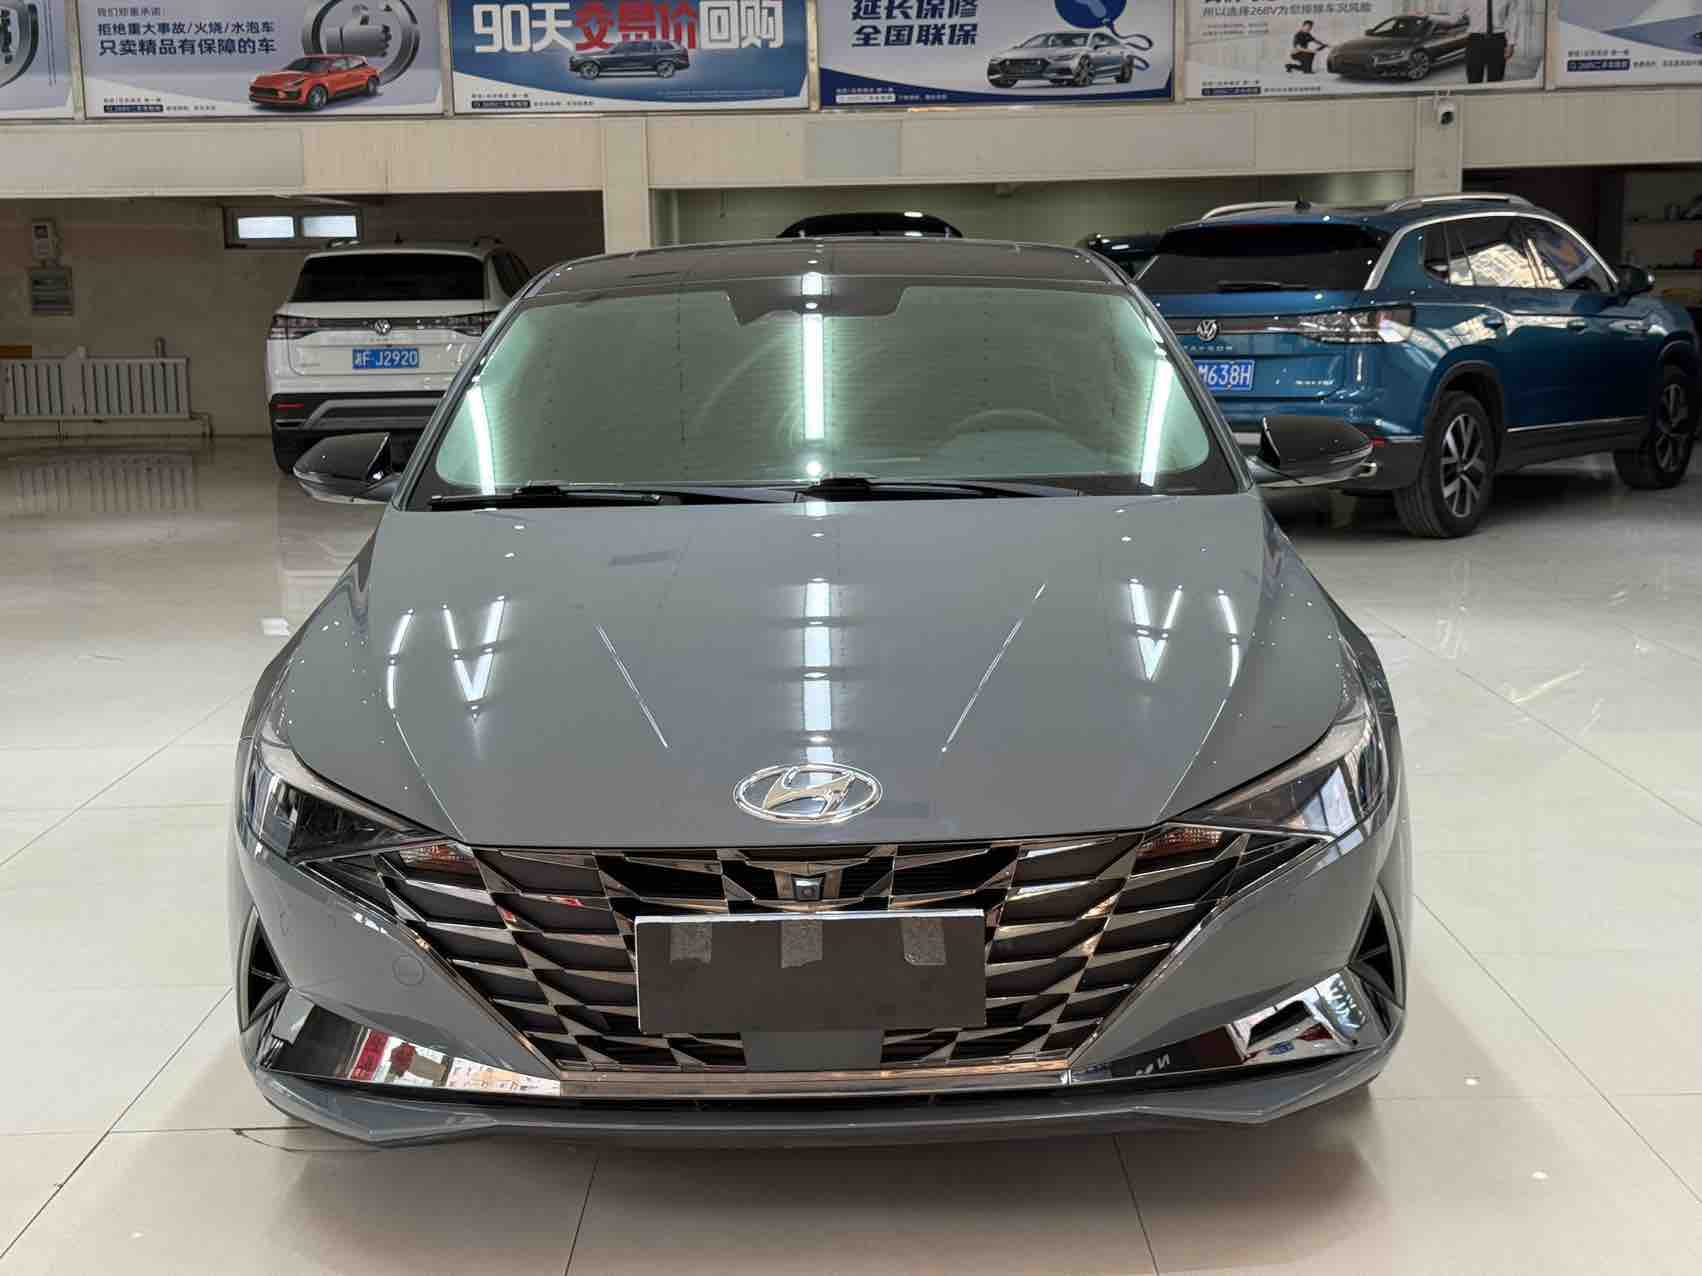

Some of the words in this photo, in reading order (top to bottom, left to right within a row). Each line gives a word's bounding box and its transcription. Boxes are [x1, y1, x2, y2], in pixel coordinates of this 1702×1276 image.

[851, 0, 978, 20] 延长保修
[98, 21, 275, 36] 拒绝重大事故/火烧/水泡车
[851, 23, 978, 48] 全国联保
[99, 38, 277, 56] 只卖精品有保障的车
